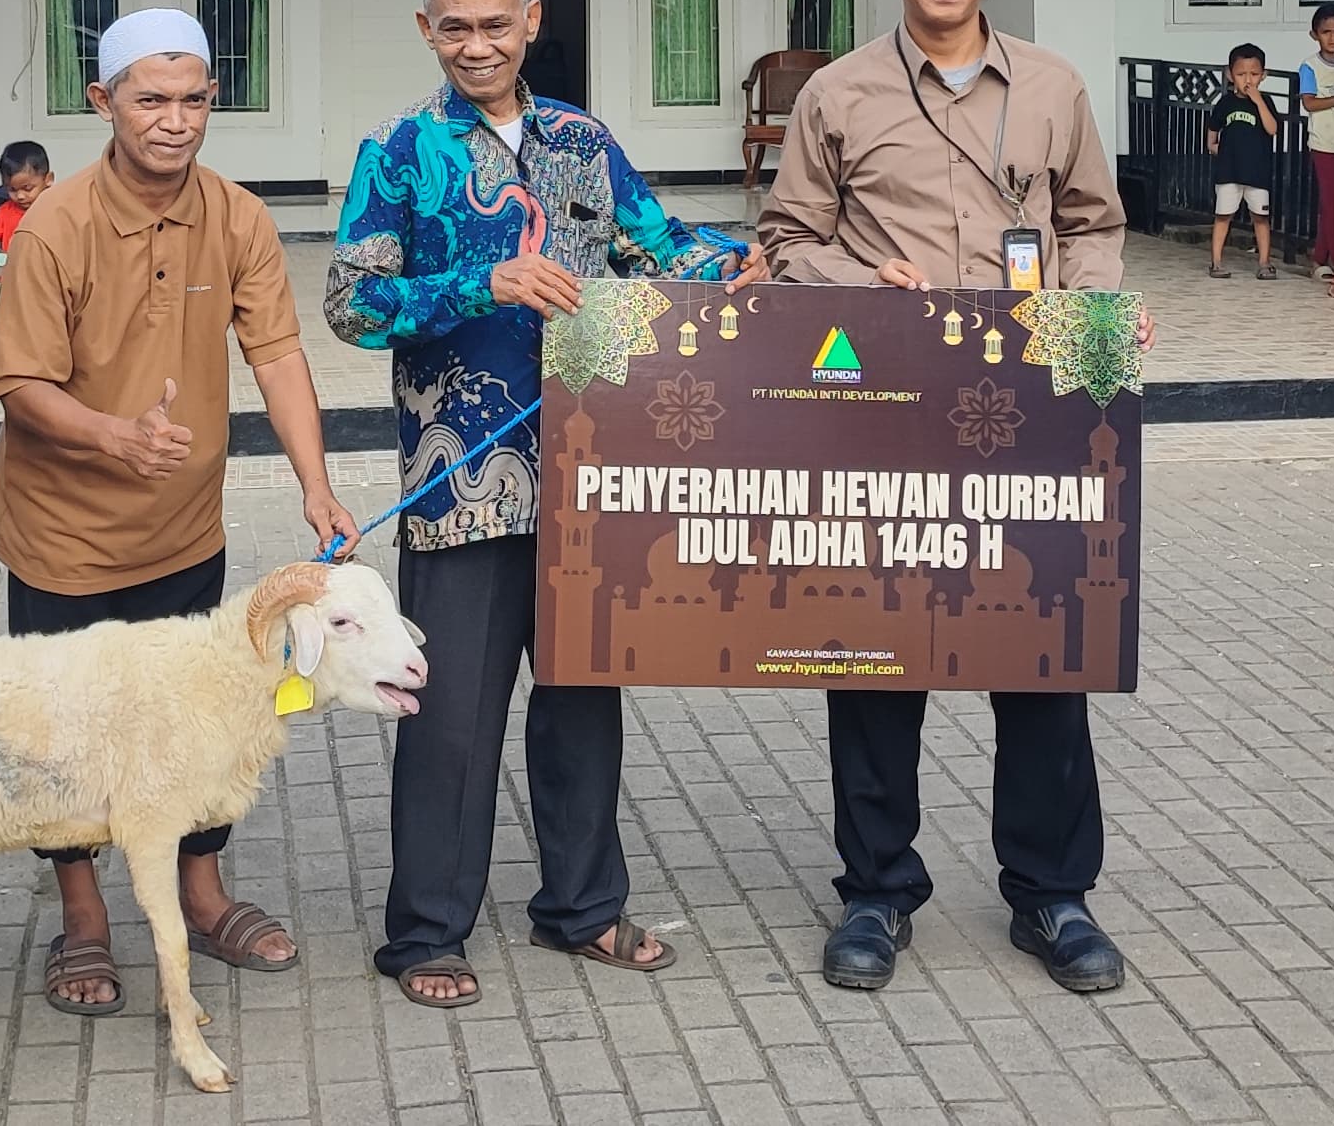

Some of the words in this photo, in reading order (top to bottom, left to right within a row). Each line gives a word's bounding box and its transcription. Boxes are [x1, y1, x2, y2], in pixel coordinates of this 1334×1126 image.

[812, 370, 861, 380] HYUNDAI
[752, 388, 767, 399] PT
[769, 389, 818, 400] HYUNDAI
[820, 390, 841, 400] INTI
[843, 391, 922, 402] DEVELOPMENT
[576, 465, 809, 516] PENYERAHAN
[821, 469, 950, 519] HEWAN
[961, 474, 1105, 523] QURBAN
[677, 518, 757, 565] IDUL
[768, 520, 866, 567] ADHA
[877, 523, 968, 569] 1446
[979, 524, 1004, 570] H
[766, 648, 812, 659] KAWASAN
[813, 649, 854, 659] INDUSTRI
[855, 651, 895, 660] HYUNDAI
[756, 661, 905, 675] www.hyundai-inti.com
